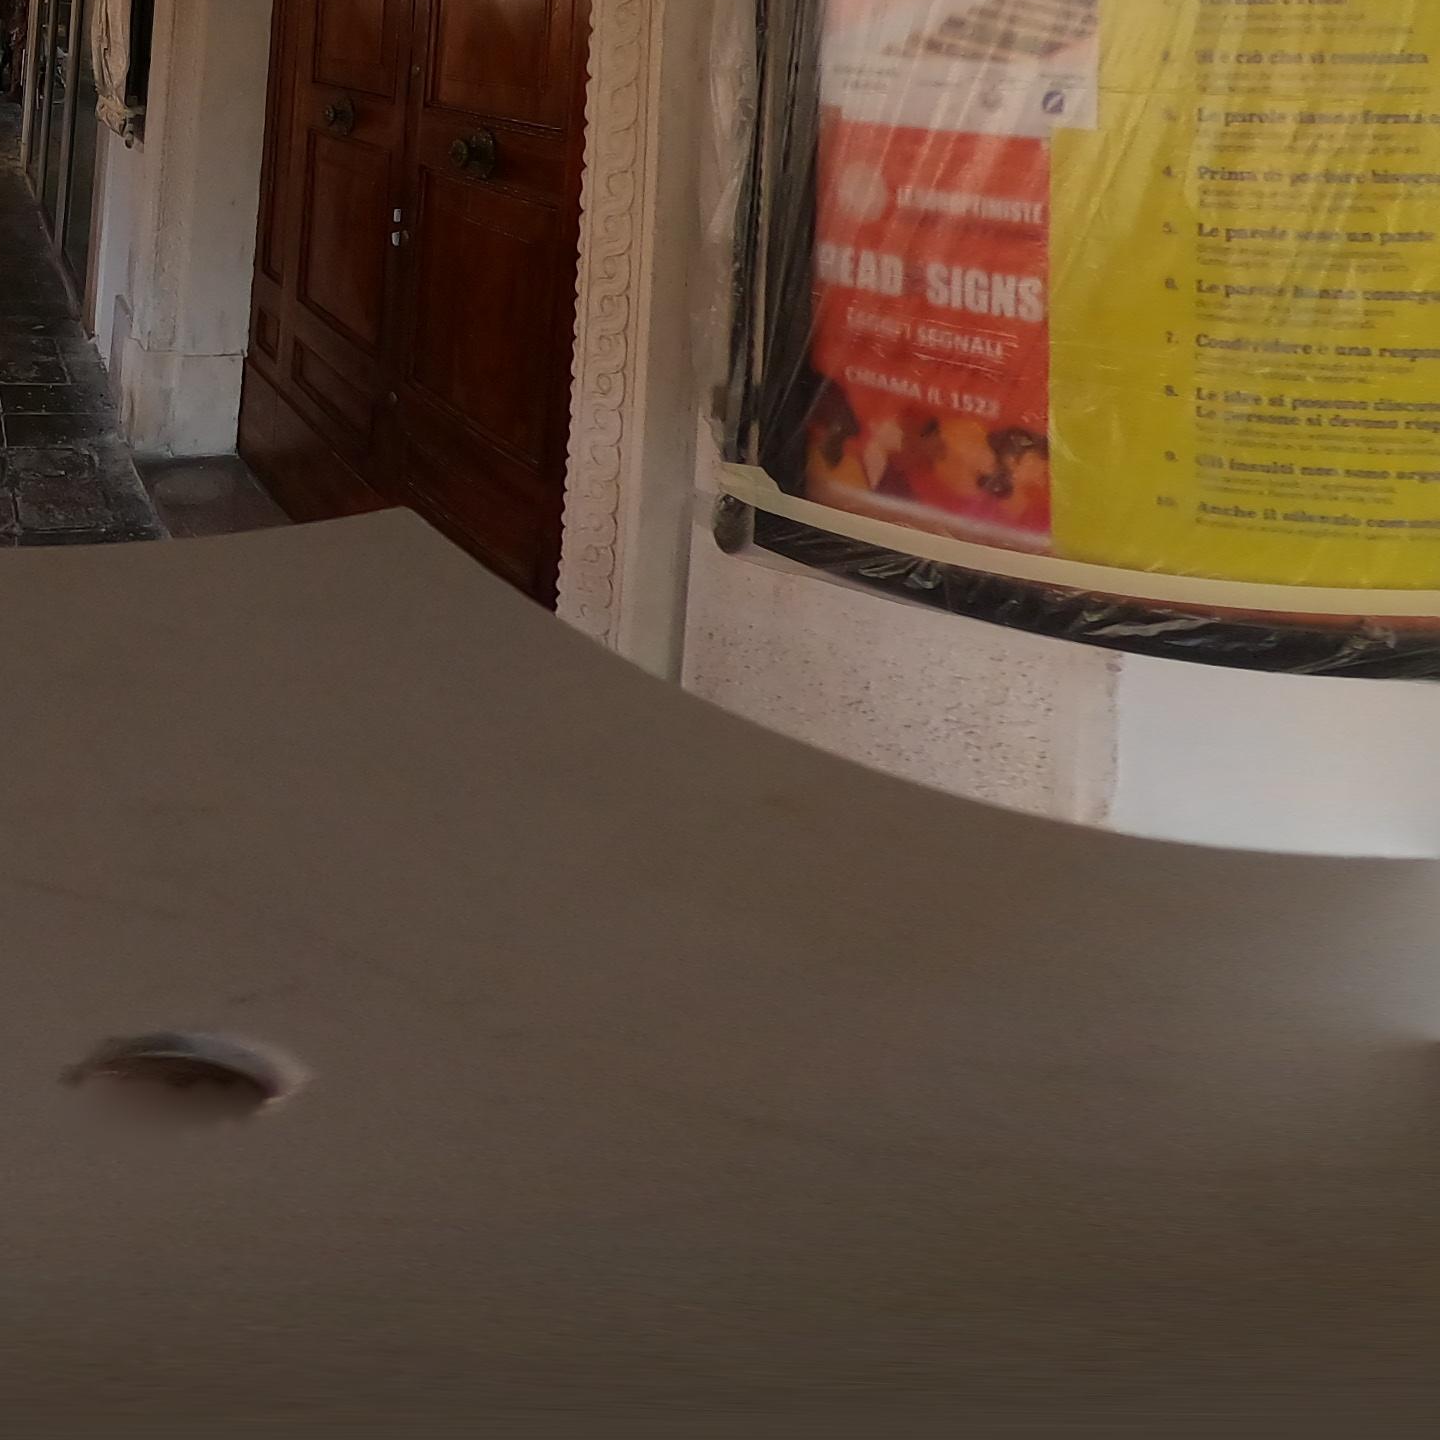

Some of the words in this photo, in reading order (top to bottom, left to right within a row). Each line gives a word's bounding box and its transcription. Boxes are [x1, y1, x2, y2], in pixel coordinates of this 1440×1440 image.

[1197, 223, 1220, 239] Le
[926, 260, 1044, 325] SIGNS
[1196, 279, 1220, 295] Le
[844, 364, 921, 399] CHIAMA
[1195, 386, 1218, 403] Le
[1196, 502, 1257, 520] Anche
